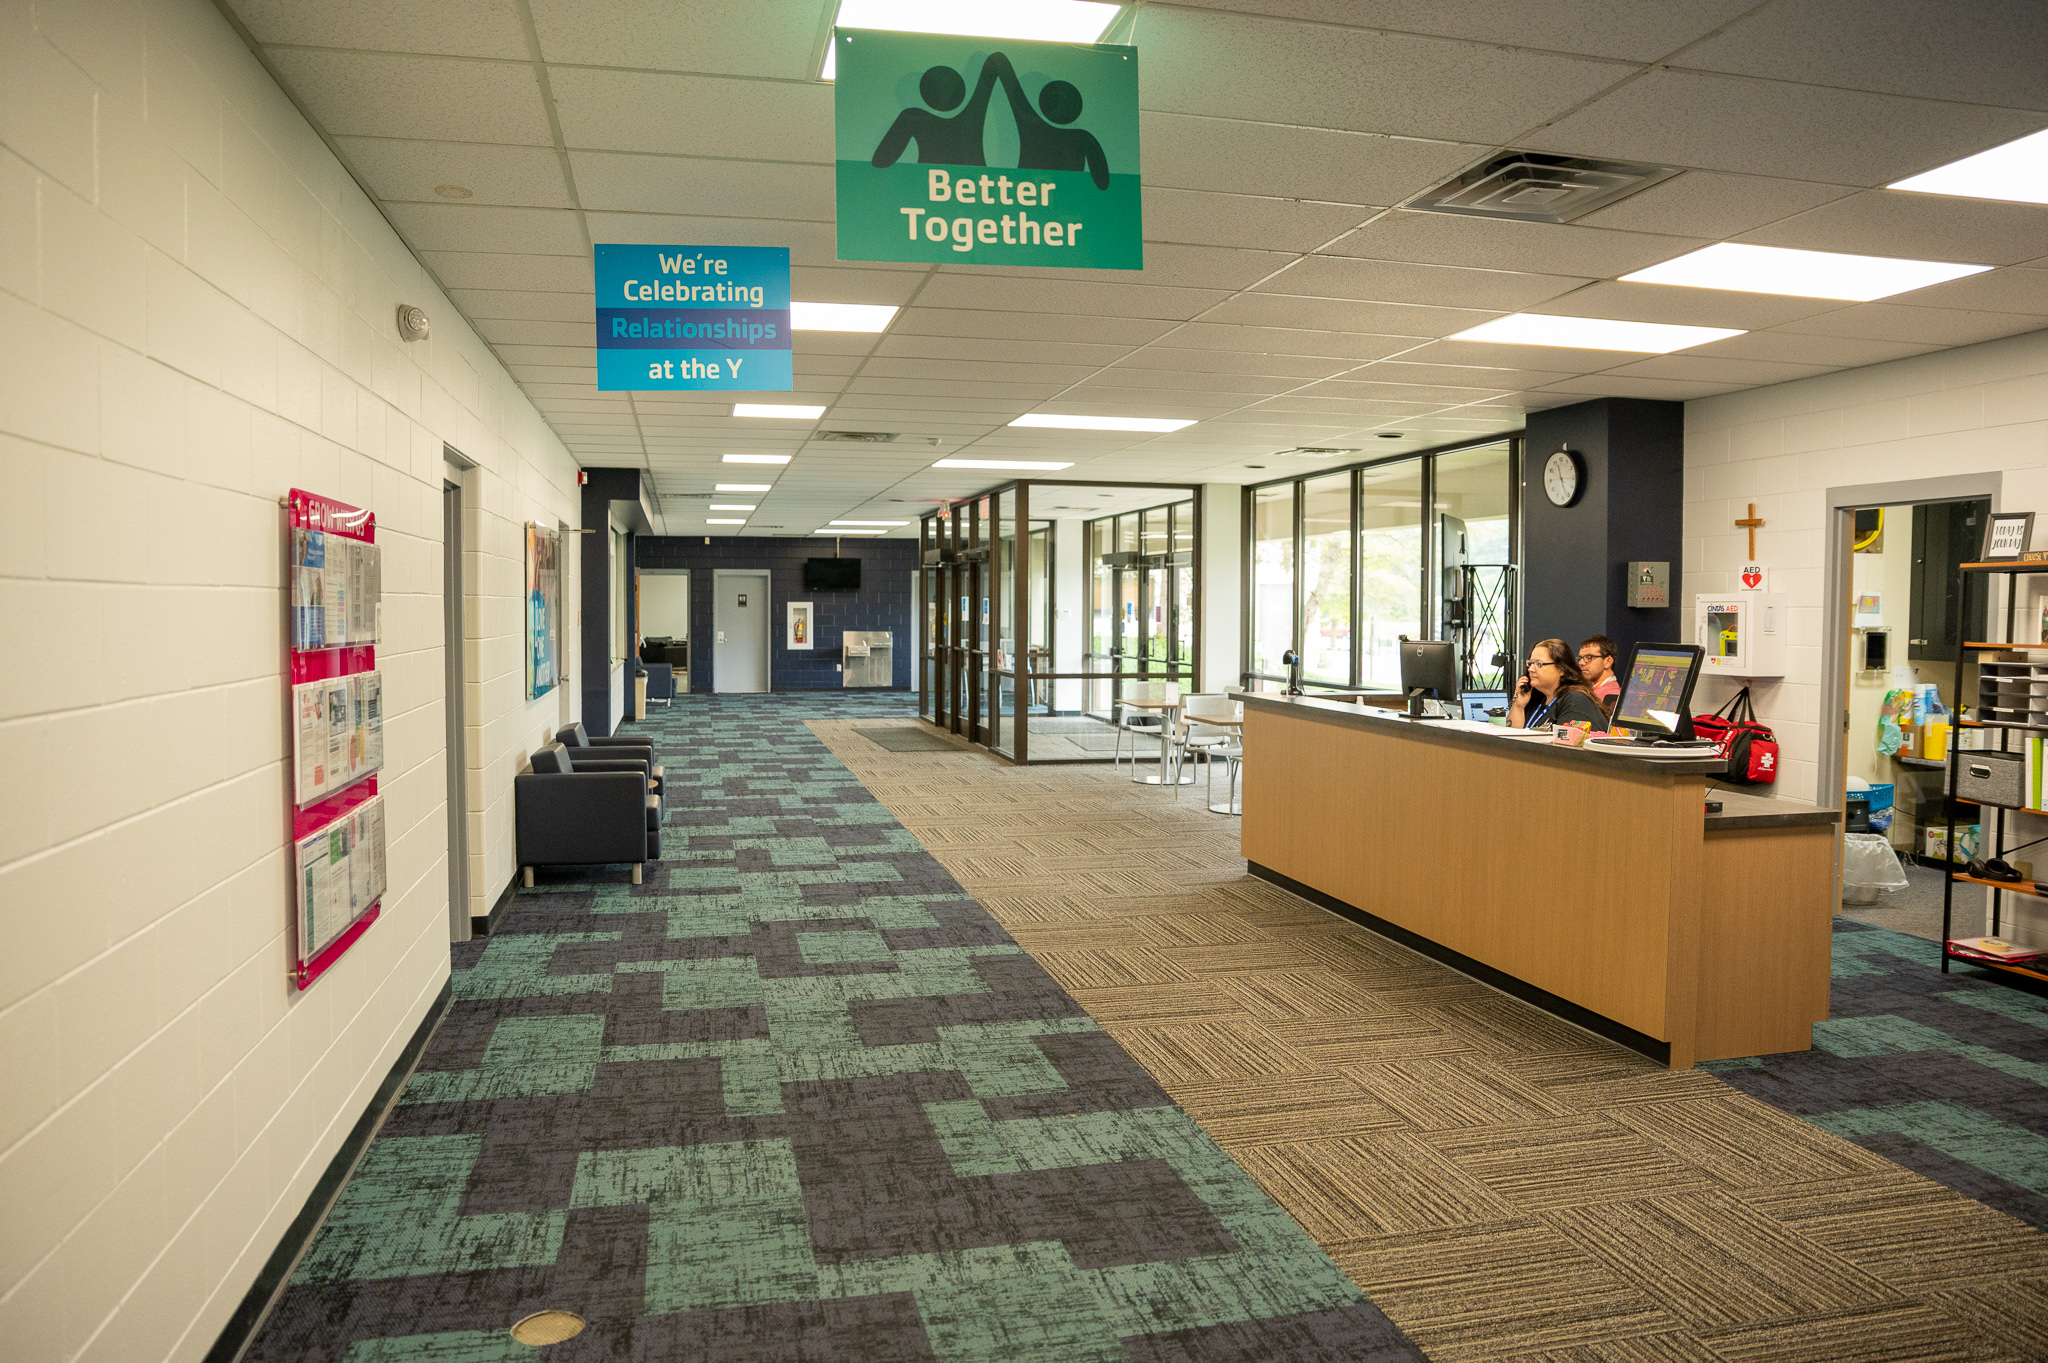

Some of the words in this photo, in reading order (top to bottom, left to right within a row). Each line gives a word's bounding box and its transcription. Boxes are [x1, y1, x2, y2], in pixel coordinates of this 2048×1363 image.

[928, 168, 1056, 206] Better
[900, 207, 1083, 252] Together
[658, 253, 728, 275] We're
[624, 280, 764, 308] Celebrating
[612, 317, 776, 344] Relationships
[648, 360, 674, 379] at
[680, 358, 720, 379] the
[726, 358, 743, 379] Y
[309, 500, 334, 530] GROW
[336, 508, 354, 534] WITH
[356, 514, 364, 536] US
